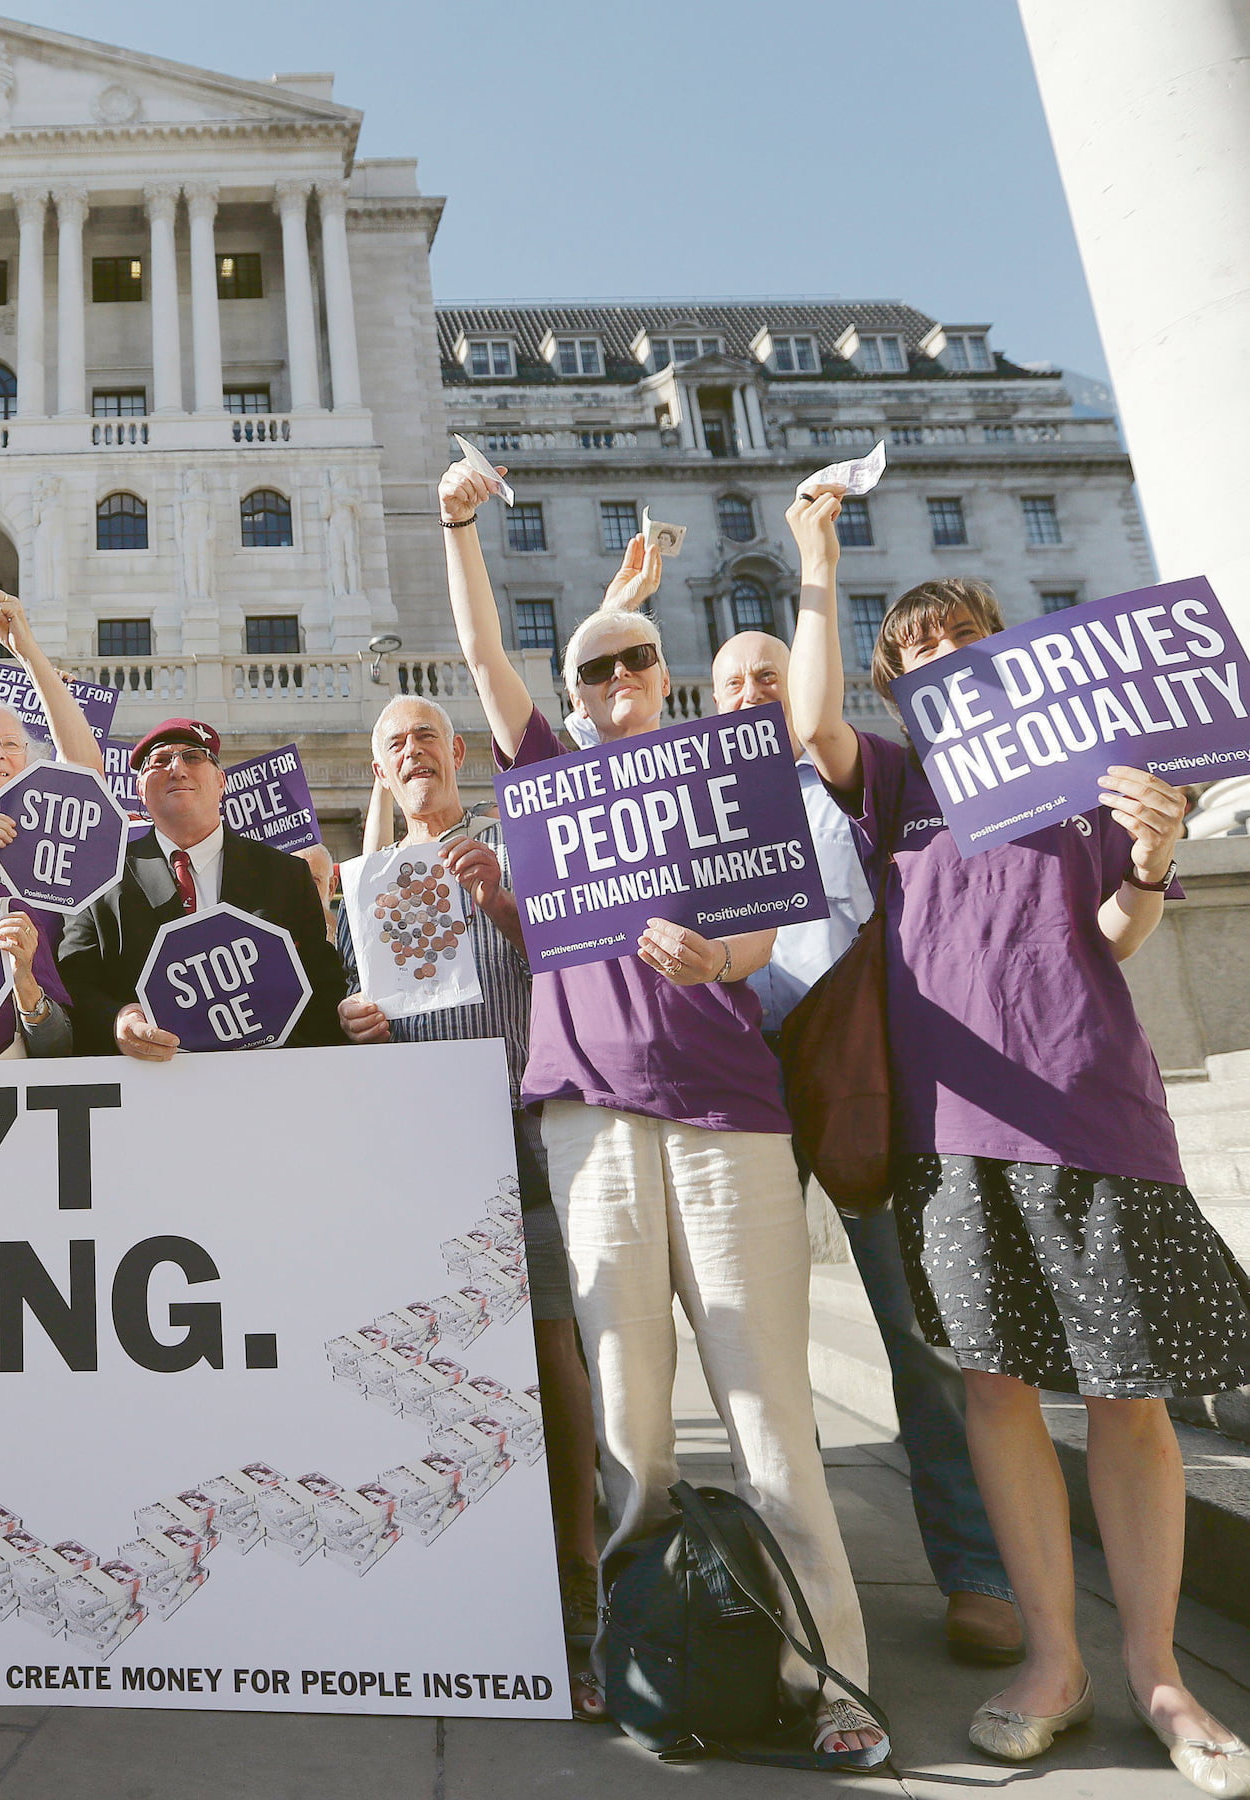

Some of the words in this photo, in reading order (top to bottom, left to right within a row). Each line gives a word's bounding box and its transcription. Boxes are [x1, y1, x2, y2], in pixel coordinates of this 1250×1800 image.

[910, 666, 994, 745] QE
[991, 599, 1226, 710] DRIVES
[87, 688, 114, 704] FOR
[933, 662, 1248, 805] INEQUALITY
[225, 762, 268, 795] MONEY
[269, 752, 298, 777] FOR
[503, 760, 607, 820] CREATE
[608, 733, 711, 791] MONEY
[718, 719, 781, 765] FOR
[1147, 748, 1250, 774] PositiveMoney
[20, 789, 102, 841] STOP
[262, 808, 312, 839] MARKETS
[545, 773, 749, 880] PEOPLE
[969, 795, 1068, 842] positivemoney.org.uk
[33, 839, 76, 886] QE
[525, 889, 567, 925] NOT
[571, 863, 690, 915] FINANCIAL
[691, 839, 806, 889] MARKETS
[24, 888, 67, 904] PositiveMoney
[696, 898, 790, 925] PositiveMoney
[541, 932, 627, 959] positivemoney.org.uk
[166, 937, 259, 1009] STOP
[207, 992, 263, 1042] QE
[6, 1665, 111, 1690] CREATE
[122, 1666, 223, 1692] MONEY
[234, 1668, 290, 1694] FOR
[301, 1670, 412, 1698] PEOPLE
[422, 1672, 553, 1701] INSTEAD
